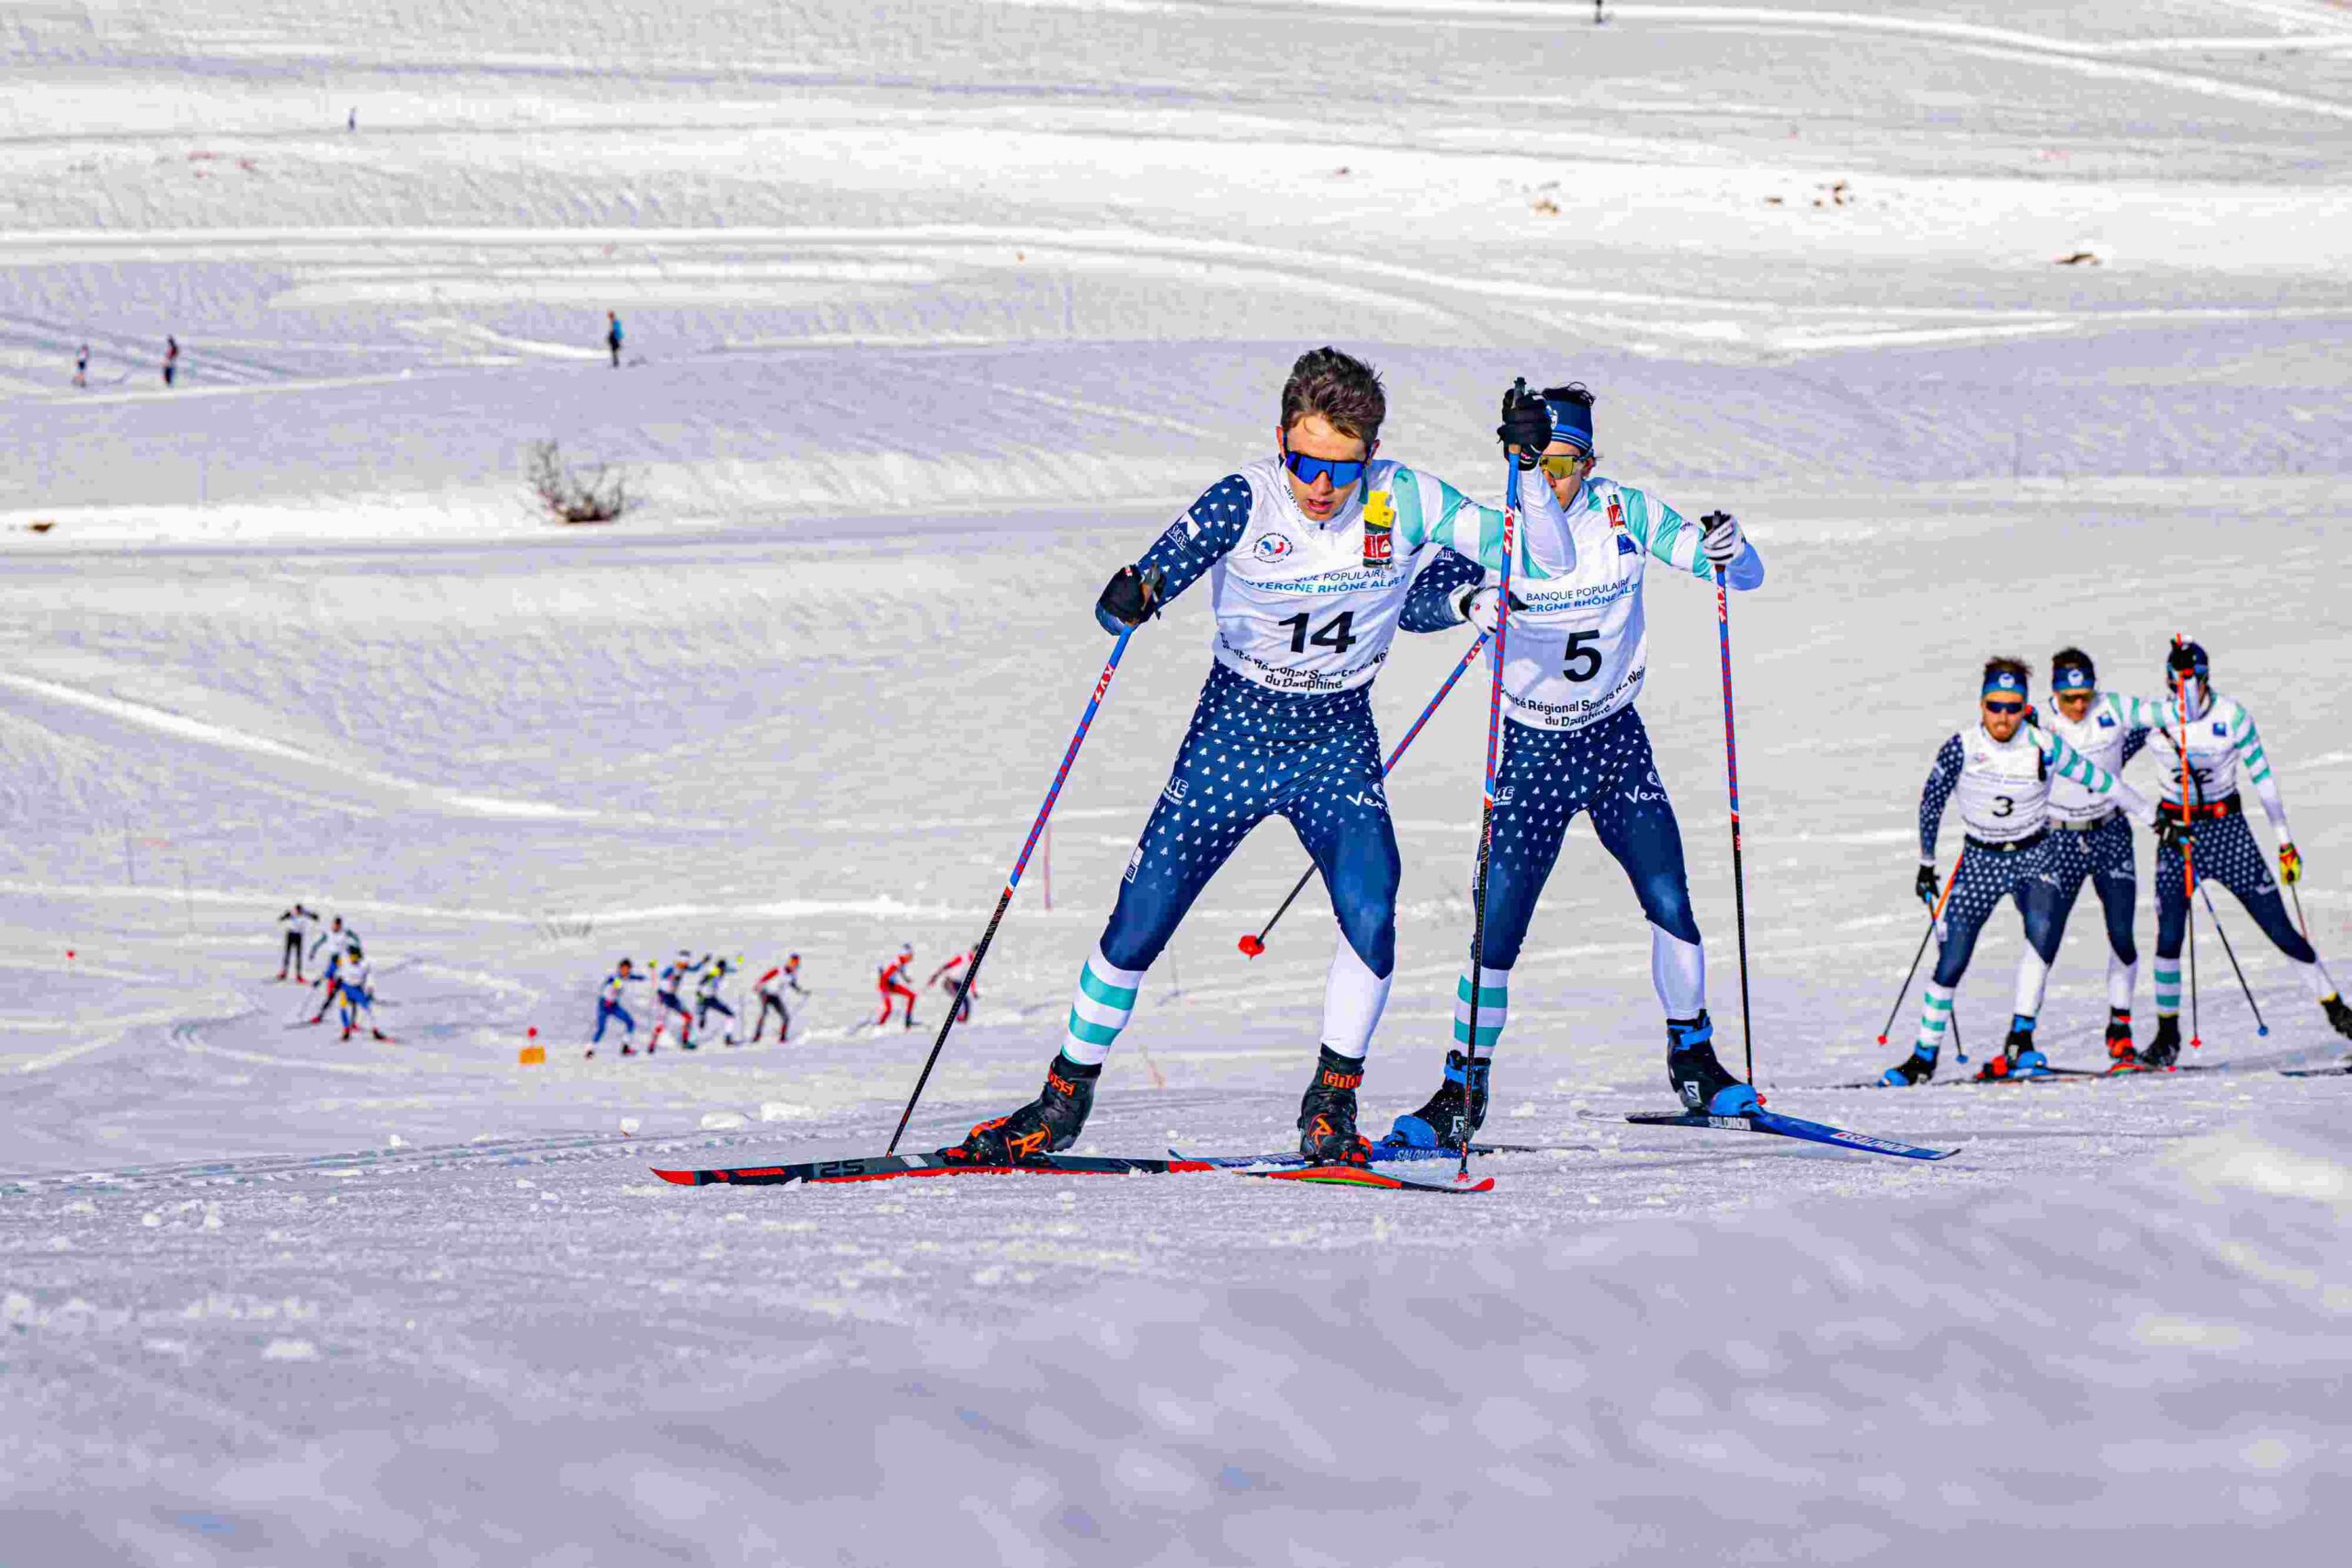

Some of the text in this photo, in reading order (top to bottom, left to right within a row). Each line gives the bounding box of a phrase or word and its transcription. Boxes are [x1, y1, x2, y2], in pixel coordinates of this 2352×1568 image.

[1239, 578, 1314, 593] UVERGNE
[1317, 581, 1367, 592] RHÔNE
[1526, 589, 1574, 601] BANQUE
[1529, 603, 1571, 613] ERGNE
[1574, 593, 1616, 606] RHÔNE
[1278, 611, 1356, 654] 14
[1563, 629, 1602, 682] 5
[1265, 674, 1280, 686] du
[1528, 699, 1579, 715] Régional
[1581, 691, 1614, 712] Sports
[1545, 716, 1559, 726] du
[1992, 795, 2015, 818] 3
[1708, 1116, 1751, 1131] SALOMON
